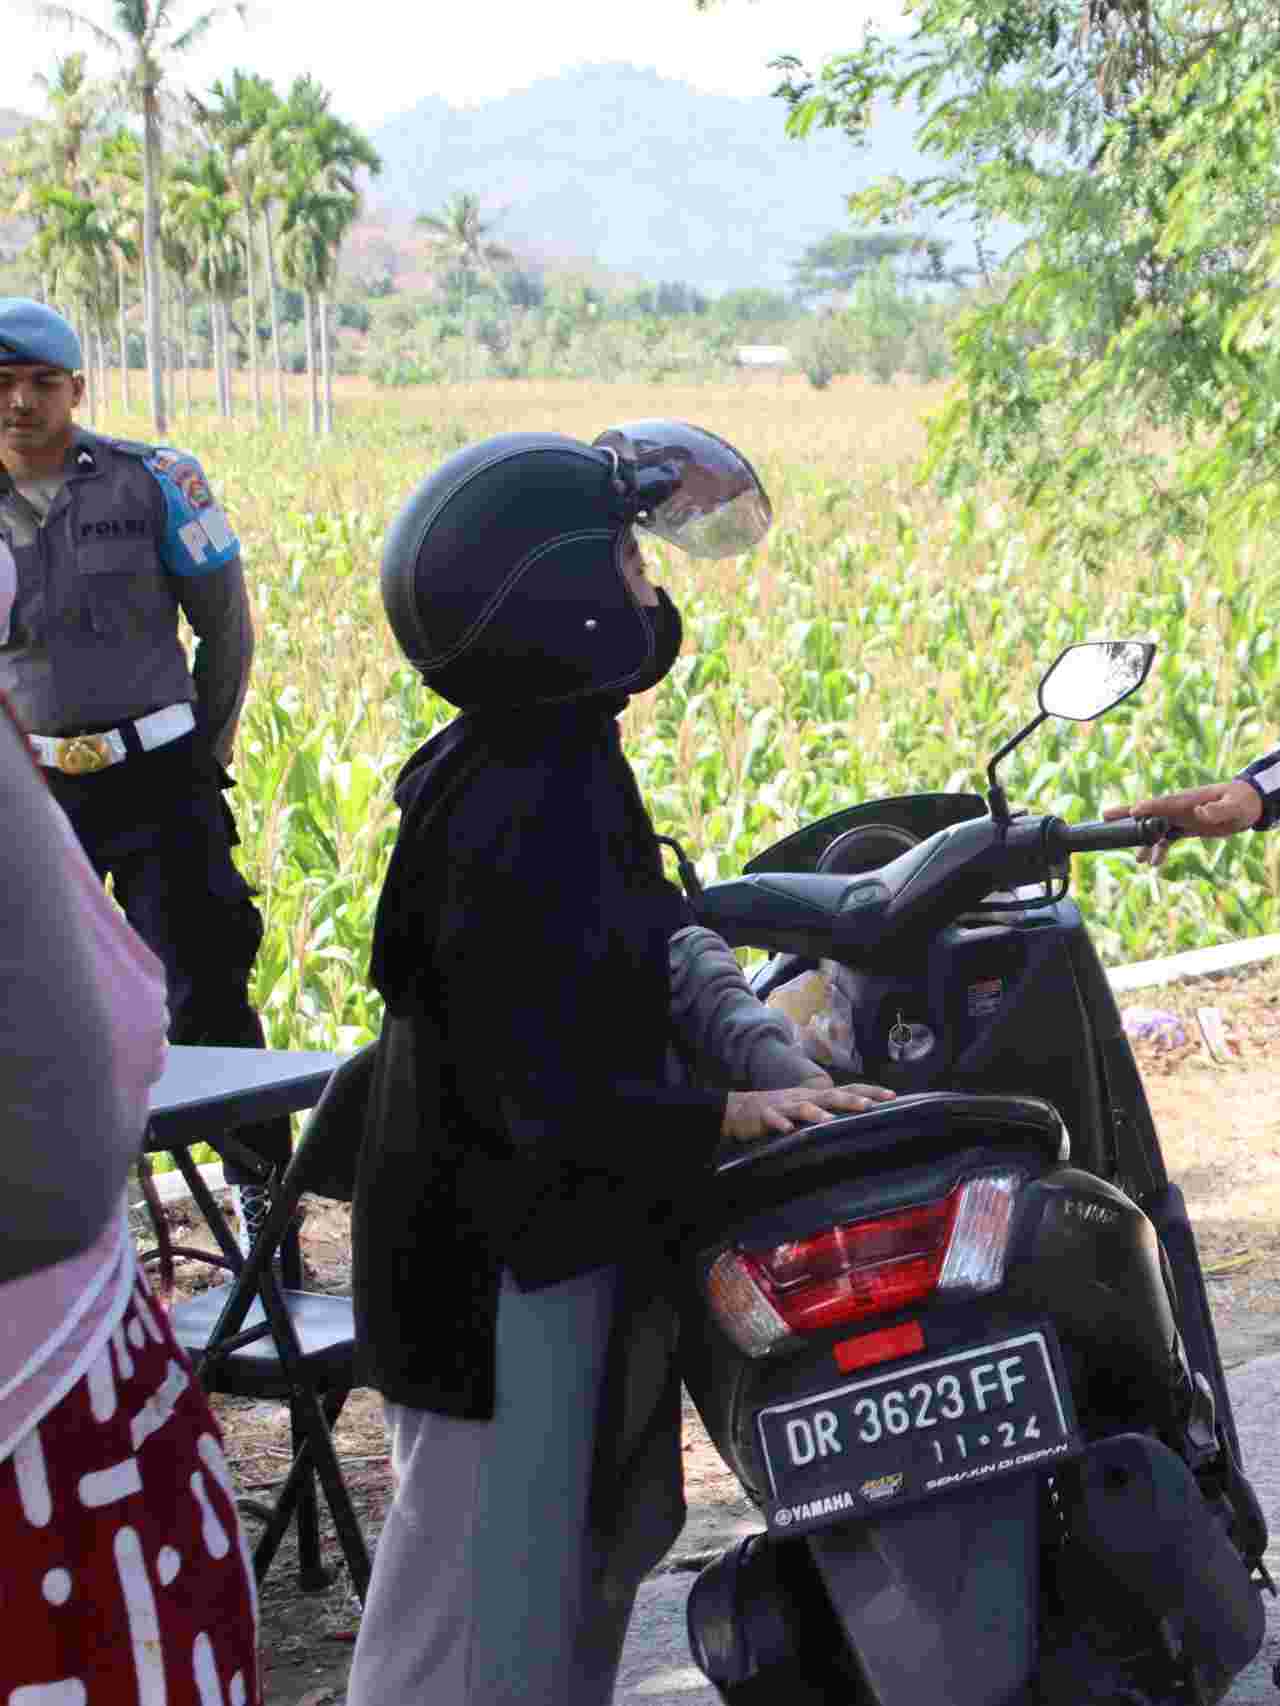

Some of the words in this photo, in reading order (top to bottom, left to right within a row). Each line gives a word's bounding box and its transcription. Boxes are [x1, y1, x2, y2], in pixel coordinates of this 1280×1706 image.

[785, 1410, 841, 1466] DR
[853, 1375, 966, 1443] 3623
[970, 1356, 1026, 1412] FF
[793, 1490, 854, 1522] YAMAHA
